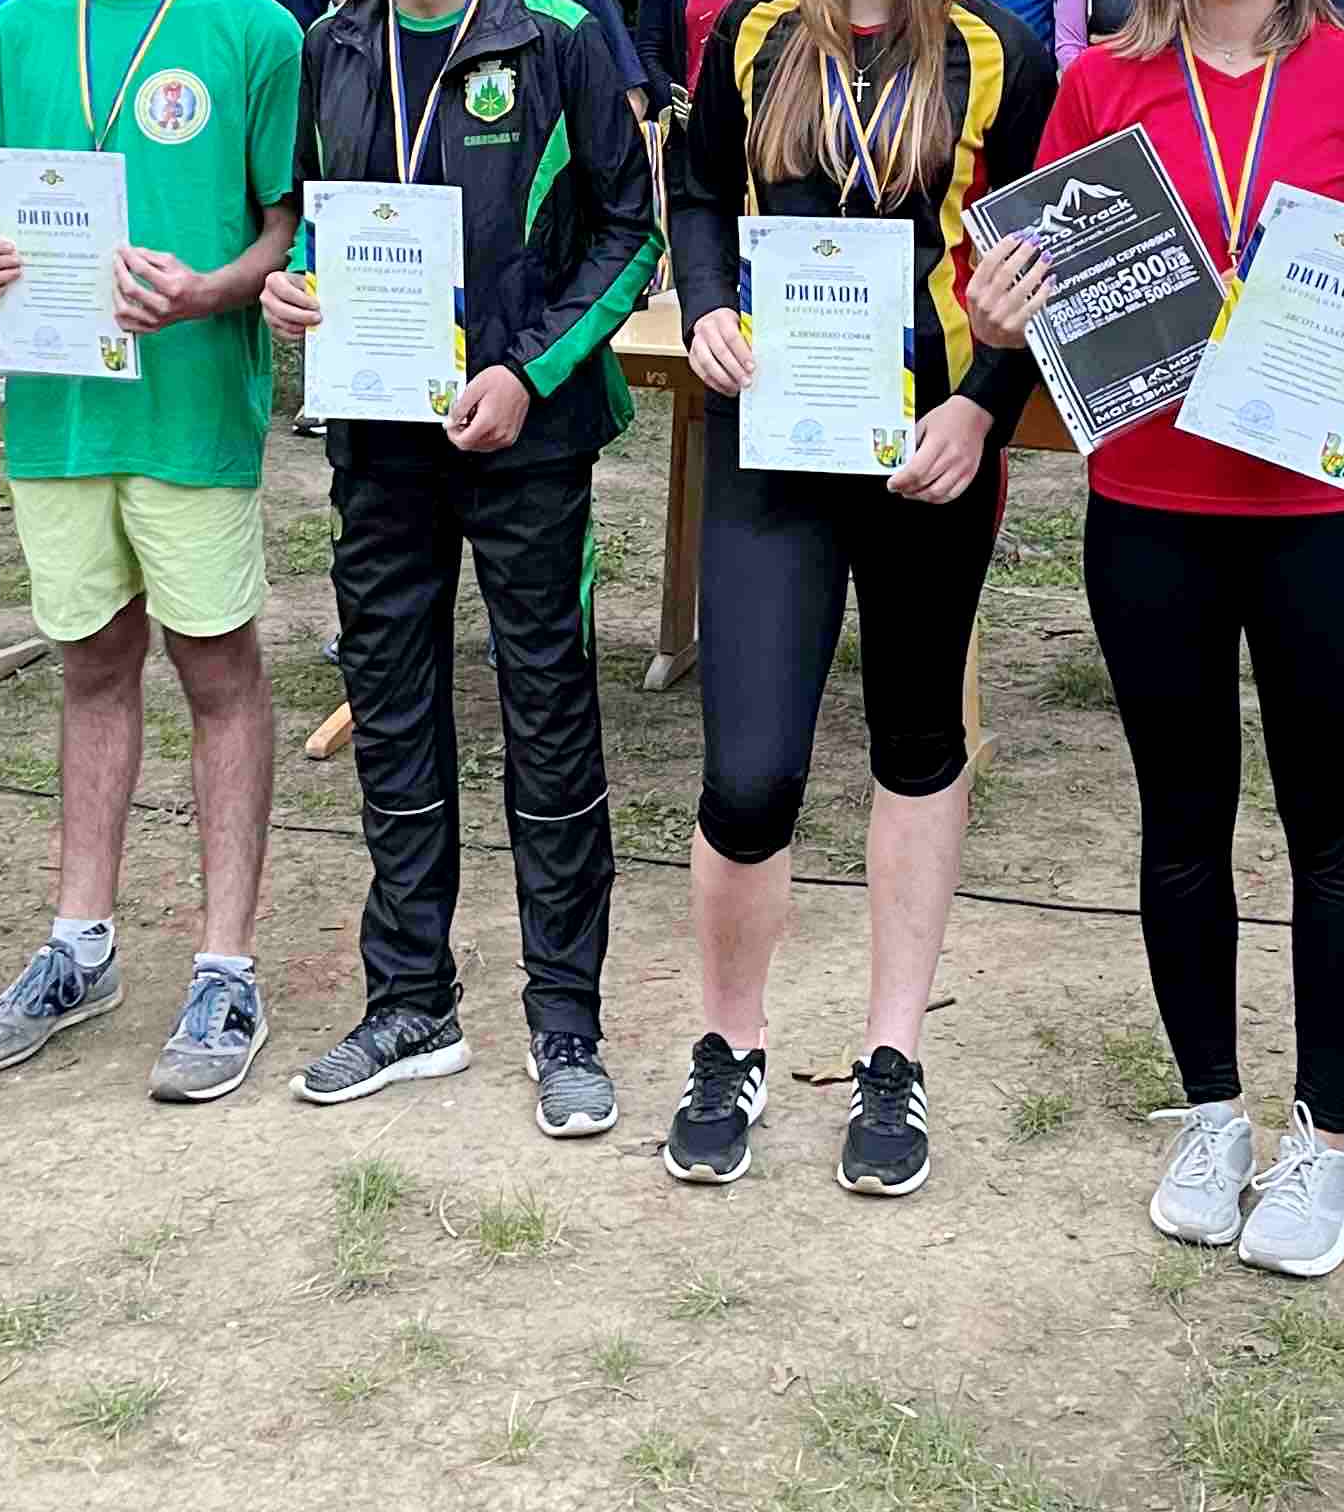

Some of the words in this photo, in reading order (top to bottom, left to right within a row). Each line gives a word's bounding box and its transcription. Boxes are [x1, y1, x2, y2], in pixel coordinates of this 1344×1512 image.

[17, 208, 89, 228] ДИПЛОМ
[1072, 198, 1131, 230] Track
[346, 244, 423, 264] ДИПЛОМ
[785, 283, 869, 304] ДИПЛОМ
